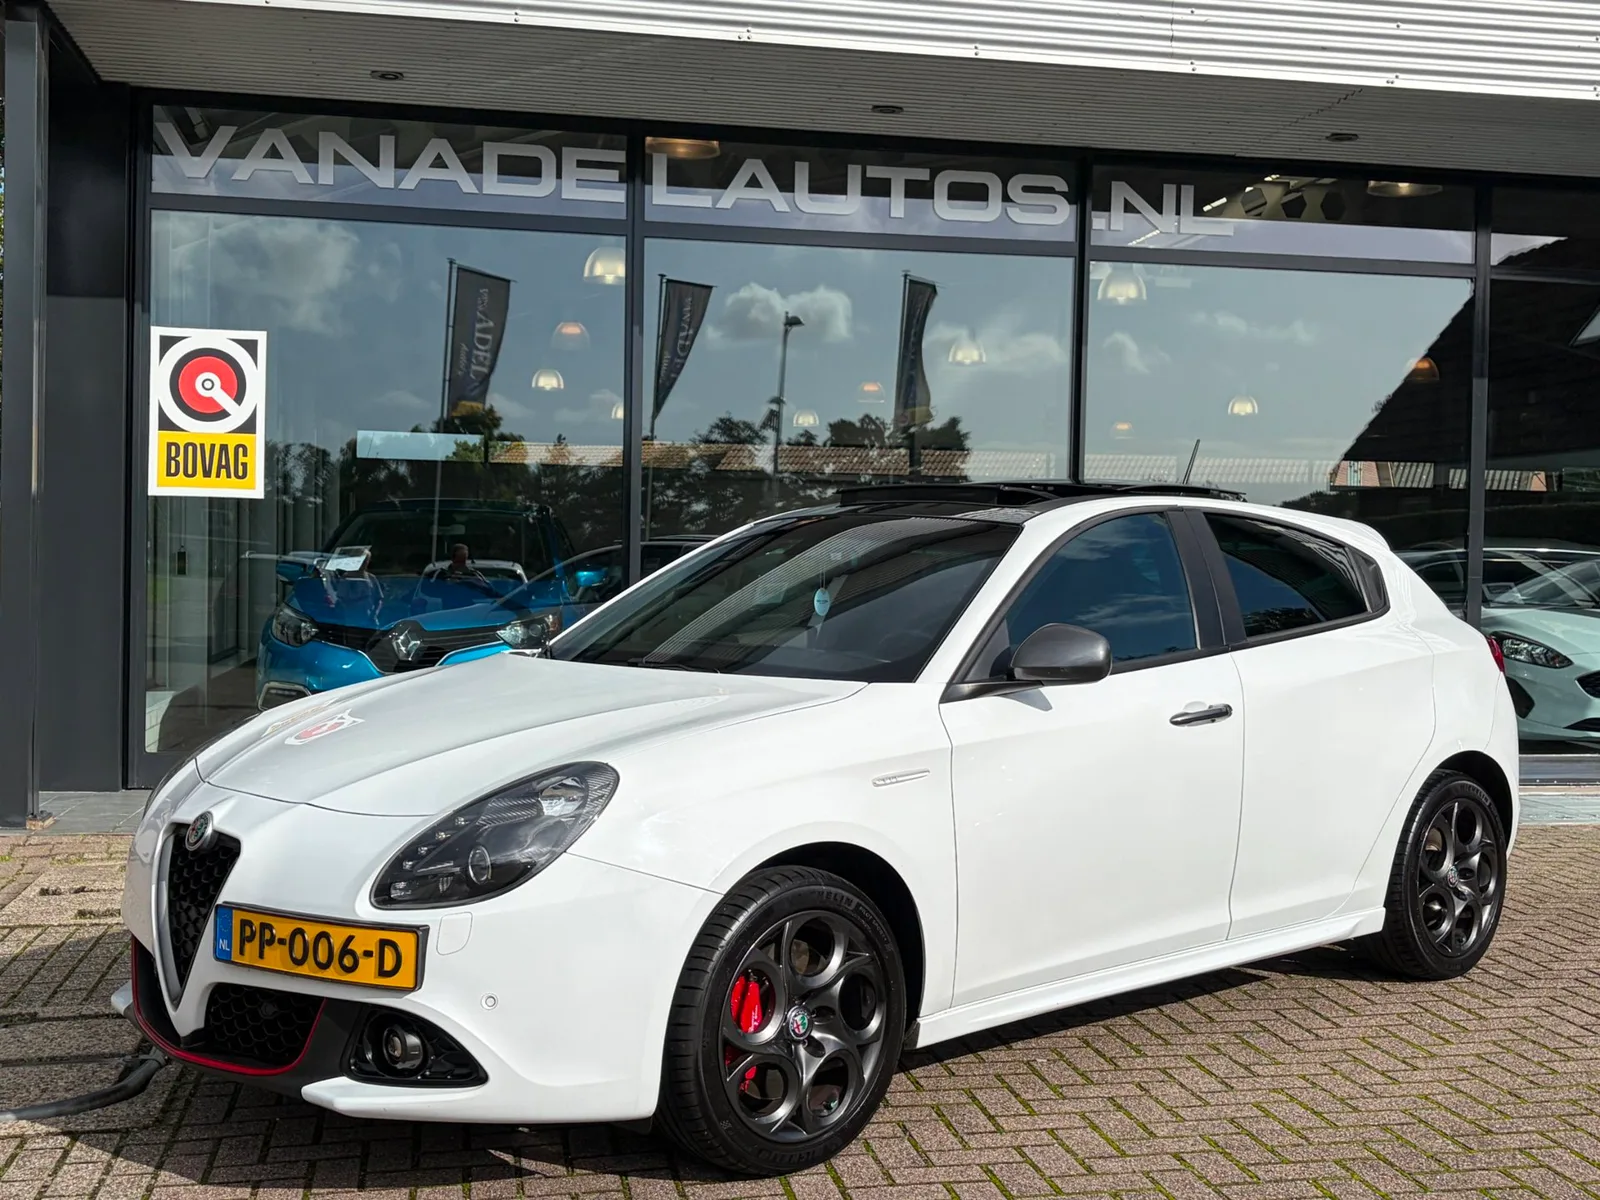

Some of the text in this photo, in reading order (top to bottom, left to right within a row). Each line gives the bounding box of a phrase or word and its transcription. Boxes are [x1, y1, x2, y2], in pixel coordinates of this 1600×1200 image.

[166, 441, 248, 480] BOVAG
[218, 938, 230, 952] NL
[238, 917, 403, 978] PP-006-D
